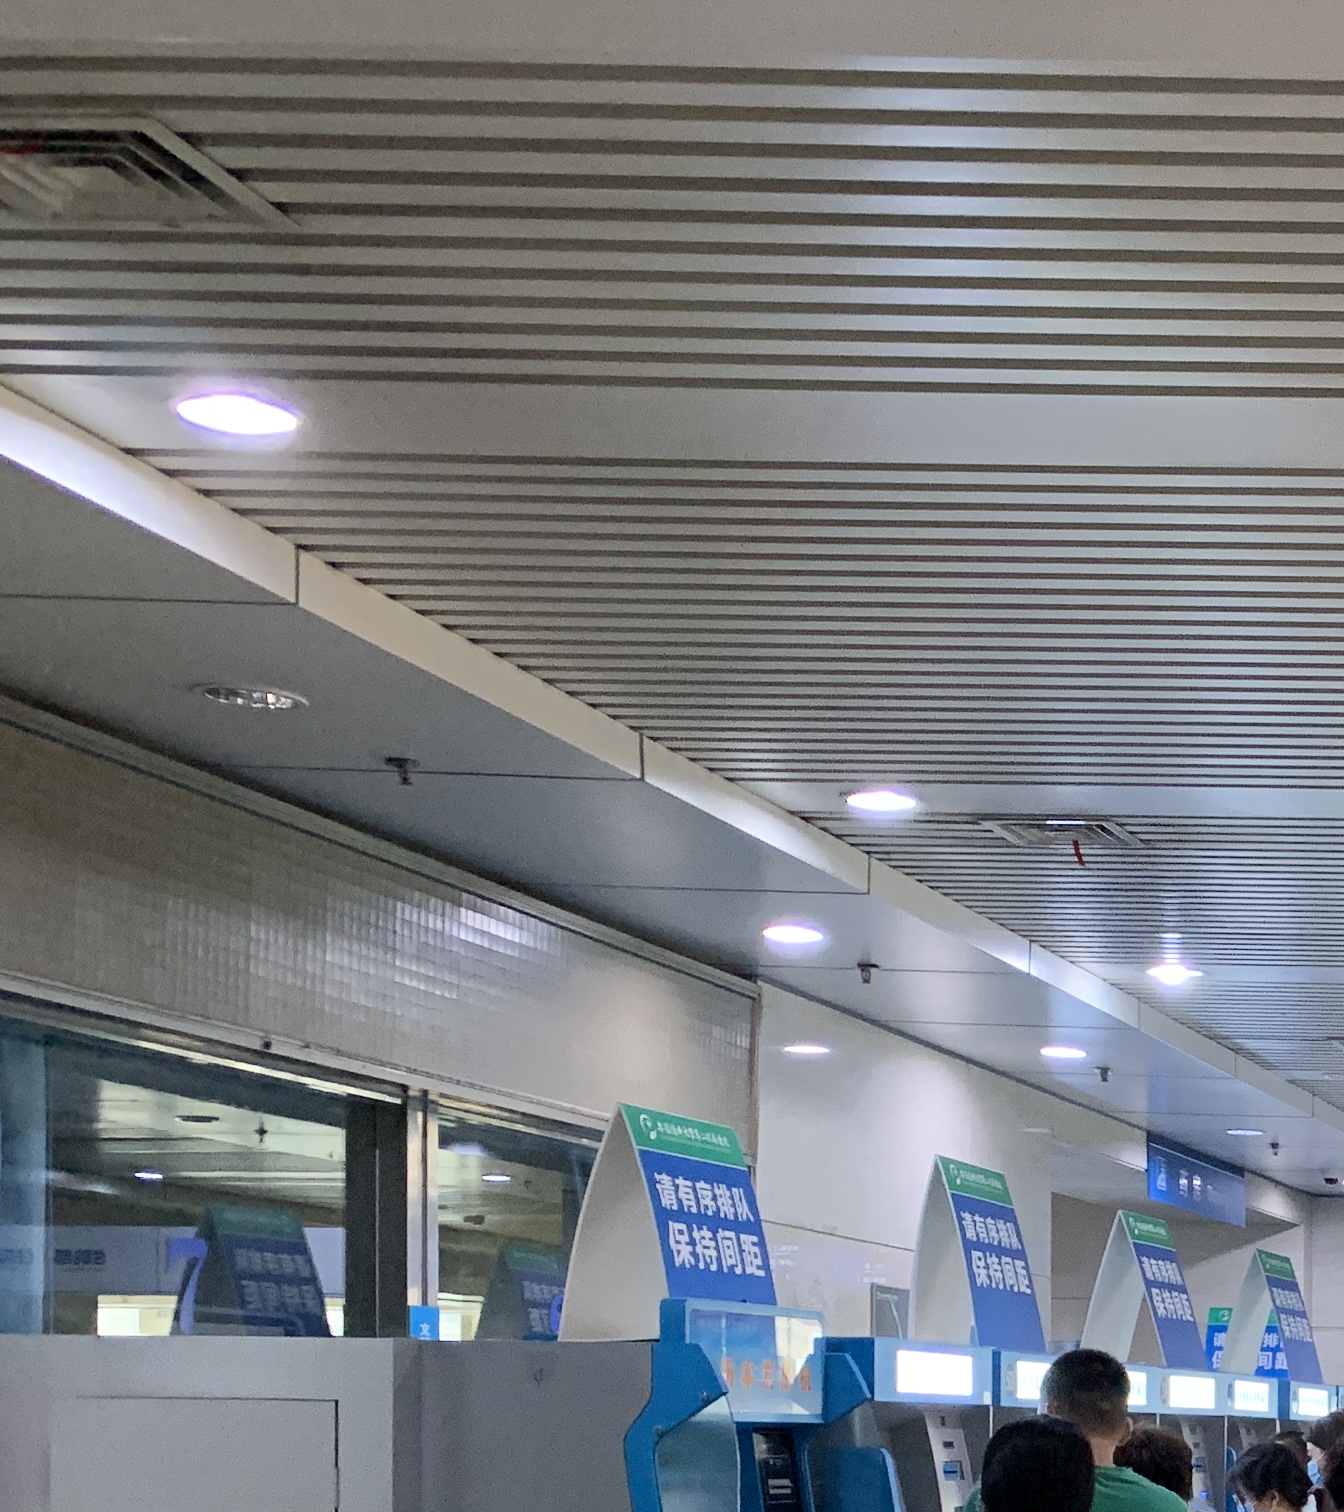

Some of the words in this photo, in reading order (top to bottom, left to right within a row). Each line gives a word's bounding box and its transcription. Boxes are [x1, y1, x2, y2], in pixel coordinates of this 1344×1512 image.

[653, 1172, 754, 1222] 请有序排队
[668, 1220, 766, 1277] 保持间距
[960, 1210, 1022, 1250] 请有序排队
[971, 1250, 1032, 1294] 保持间距
